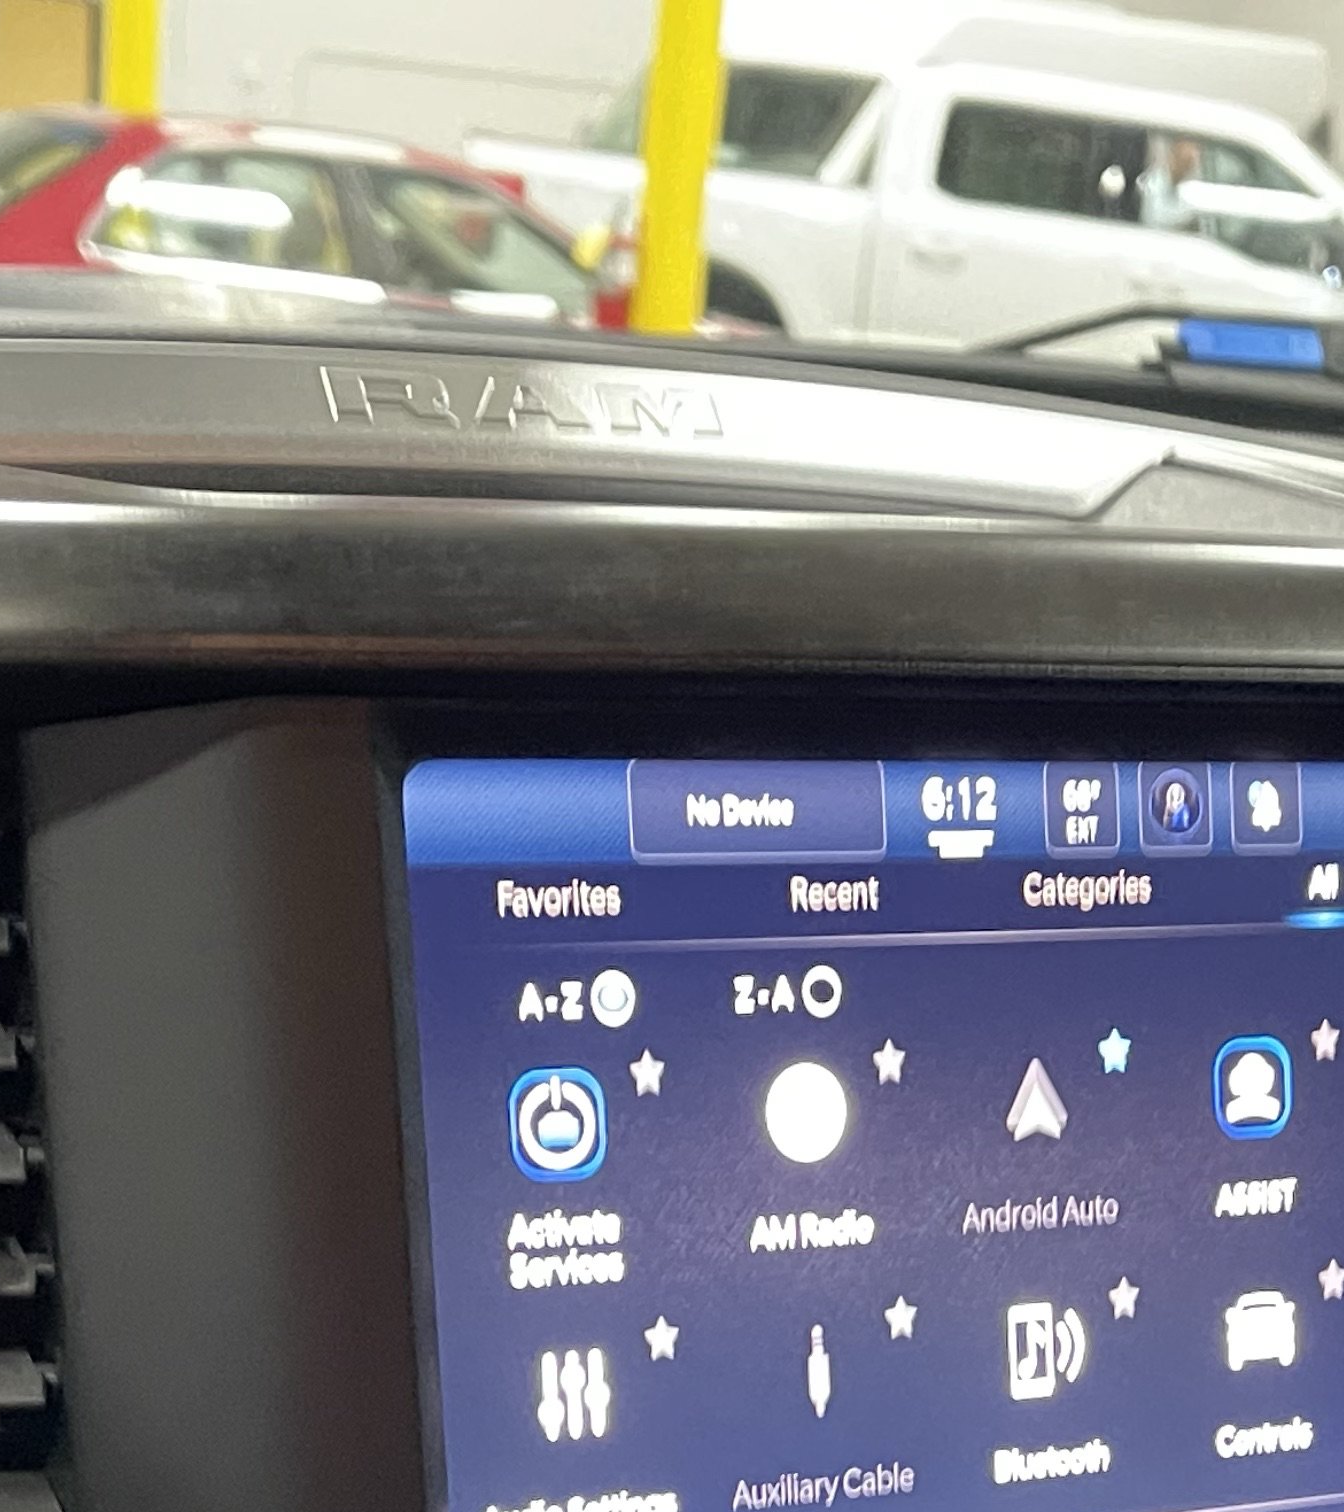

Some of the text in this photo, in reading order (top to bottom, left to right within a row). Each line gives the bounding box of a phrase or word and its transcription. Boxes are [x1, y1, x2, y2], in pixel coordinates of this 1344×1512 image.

[319, 364, 725, 438] RAM
[686, 793, 795, 827] No Device
[921, 775, 998, 822] 6:12
[496, 878, 622, 918] Favorites
[789, 875, 880, 913] Recent
[1022, 868, 1153, 912] Categories
[1307, 862, 1341, 901] All
[961, 1193, 1120, 1235] Android Auto
[1214, 1176, 1299, 1218] ASSIST
[507, 1208, 622, 1252] Activate
[749, 1208, 876, 1253] AM Radio
[508, 1248, 625, 1290] Services
[1214, 1415, 1315, 1461] Controls
[992, 1437, 1112, 1485] Bluetooth
[731, 1462, 916, 1512] Auxiliary Cable
